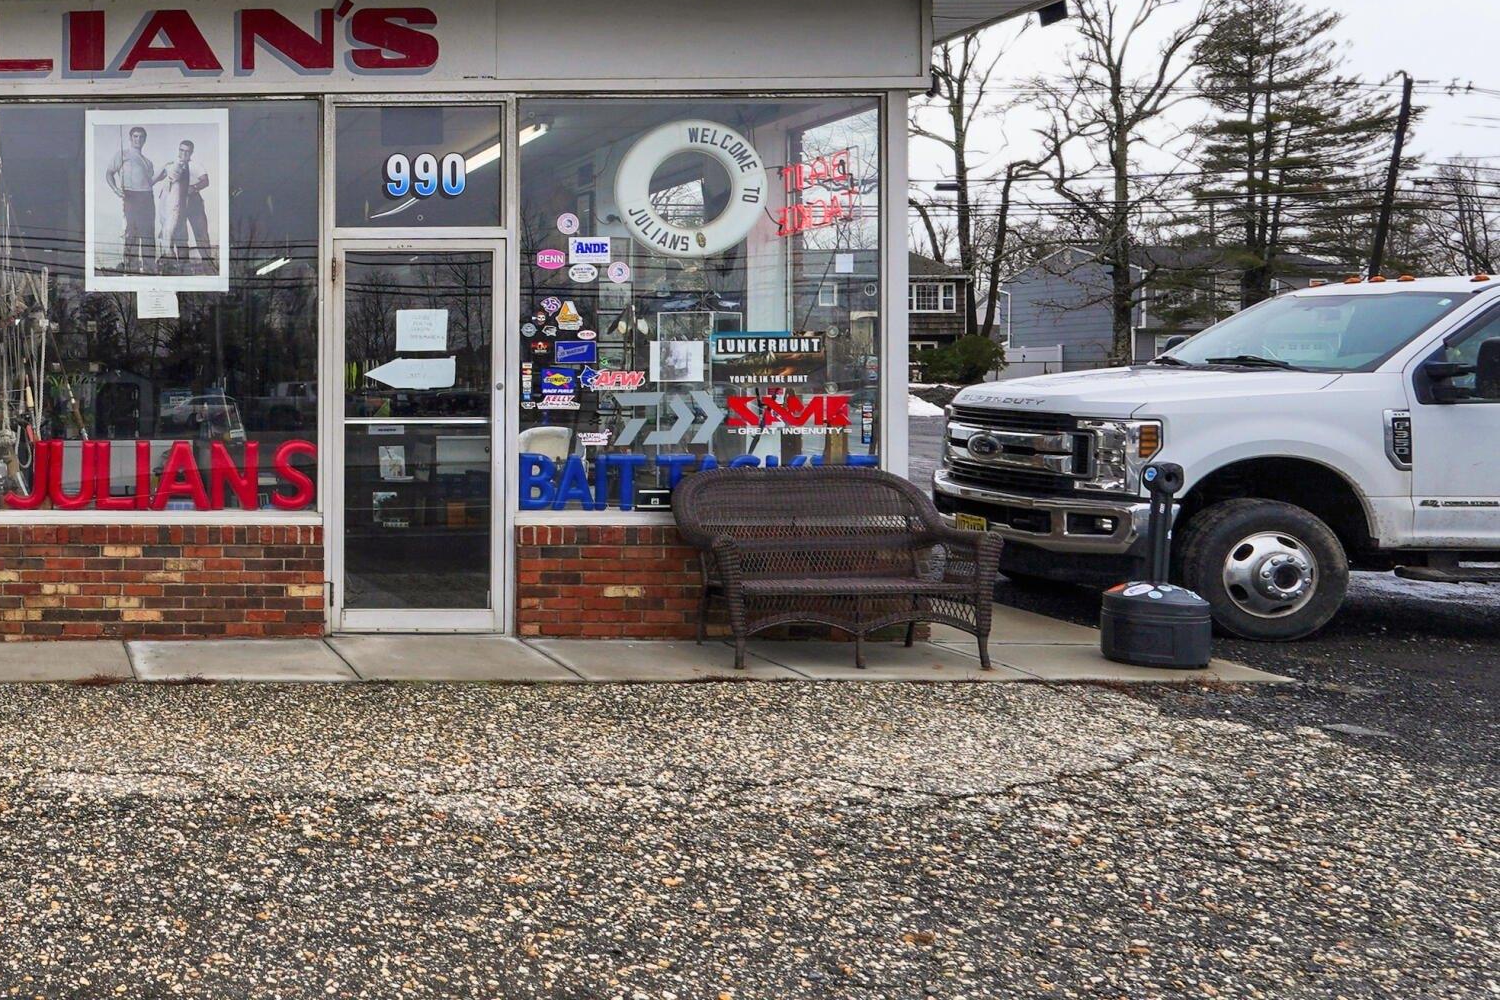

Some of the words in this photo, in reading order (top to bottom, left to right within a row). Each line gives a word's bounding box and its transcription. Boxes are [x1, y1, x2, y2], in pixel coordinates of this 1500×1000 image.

[688, 127, 757, 173] WELCOME
[742, 187, 760, 204] TO
[383, 152, 467, 199] 990
[628, 208, 690, 251] JULIANS
[575, 241, 609, 254] ANDE
[538, 254, 564, 264] PENN
[717, 338, 820, 353] LUNKERHUNT
[595, 371, 645, 387] AFW
[729, 375, 757, 384] YOU'RE
[760, 375, 768, 383] IN
[770, 375, 785, 383] THE
[787, 374, 808, 383] HUNT
[1002, 397, 1045, 406] DUTY
[737, 427, 777, 435] GREAT
[782, 427, 843, 435] INGENUITY
[4, 439, 318, 511] JULIANS
[519, 453, 647, 511] BAIT
